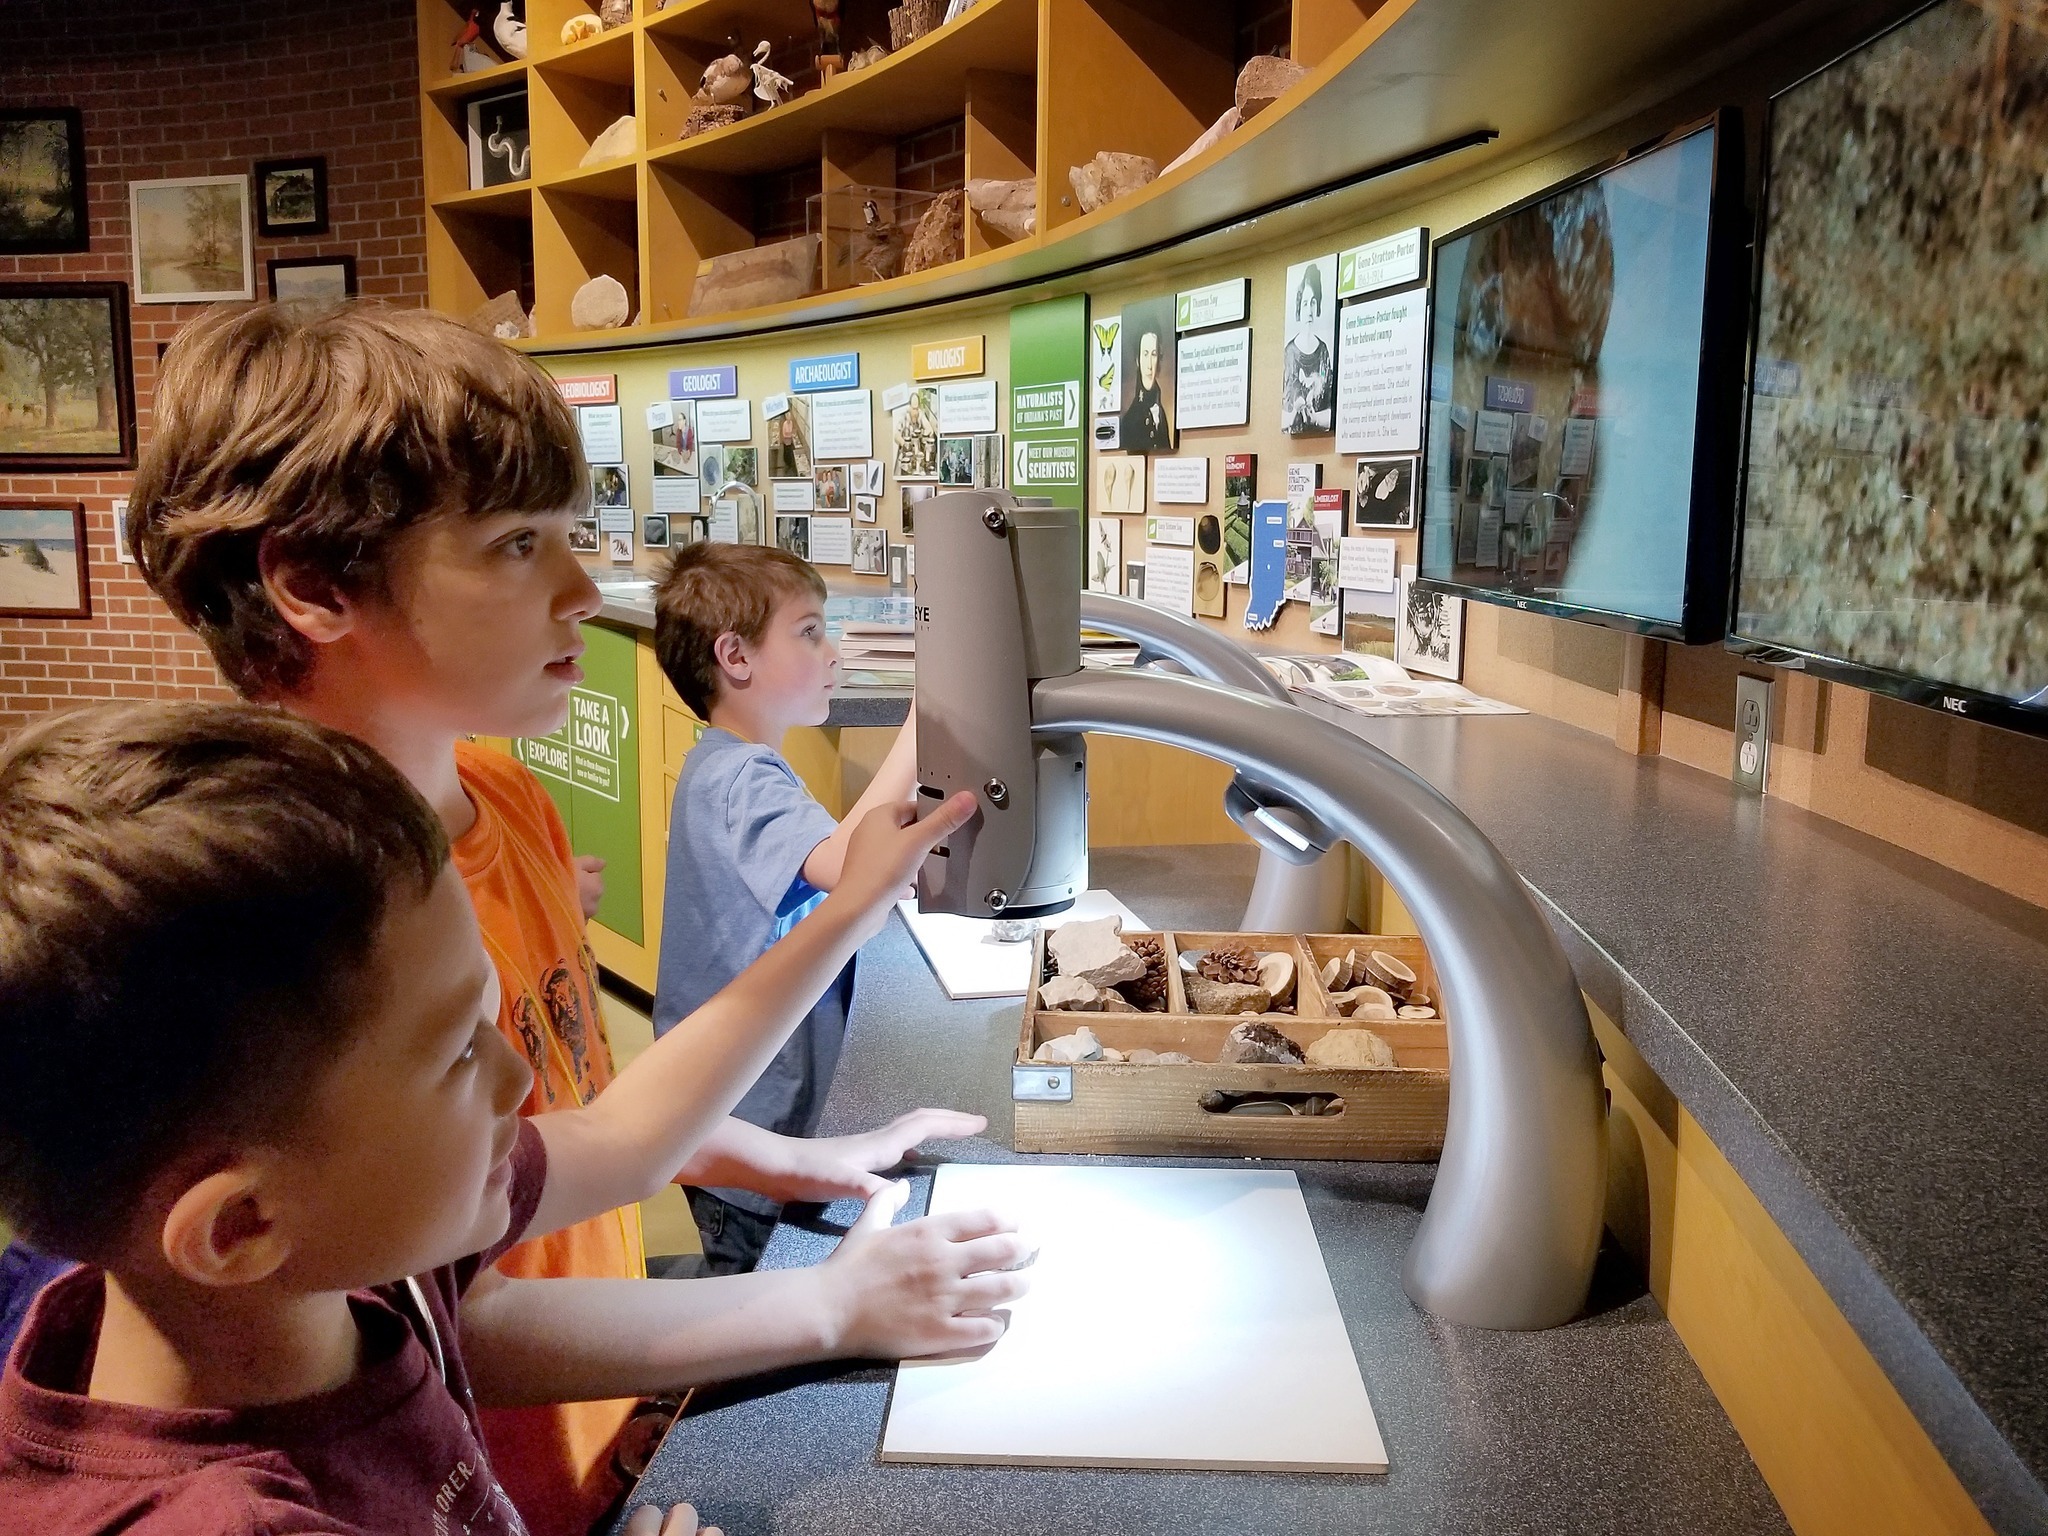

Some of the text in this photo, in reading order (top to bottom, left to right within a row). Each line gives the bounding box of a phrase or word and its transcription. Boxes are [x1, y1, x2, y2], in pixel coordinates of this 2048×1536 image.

[1358, 243, 1414, 269] Gene Stratton-Porter
[928, 347, 965, 370] BIOLOGIST
[795, 362, 852, 384] ARCHAEOLOGIST
[559, 381, 610, 398] LEOBIOLOGIST
[683, 374, 721, 392] GEOLOGIST
[1017, 391, 1063, 409] NATURALISTS
[1017, 409, 1062, 423] OF INDIANA'S PAST
[1029, 447, 1075, 458] MEET OUR MUSEUM
[1029, 462, 1075, 478] SCIENTISTS
[1517, 601, 1527, 609] NEC
[573, 696, 610, 726] TAKE A
[1943, 696, 1967, 713] NEC
[576, 720, 610, 755] LOOK
[529, 740, 568, 771] EXPLORE
